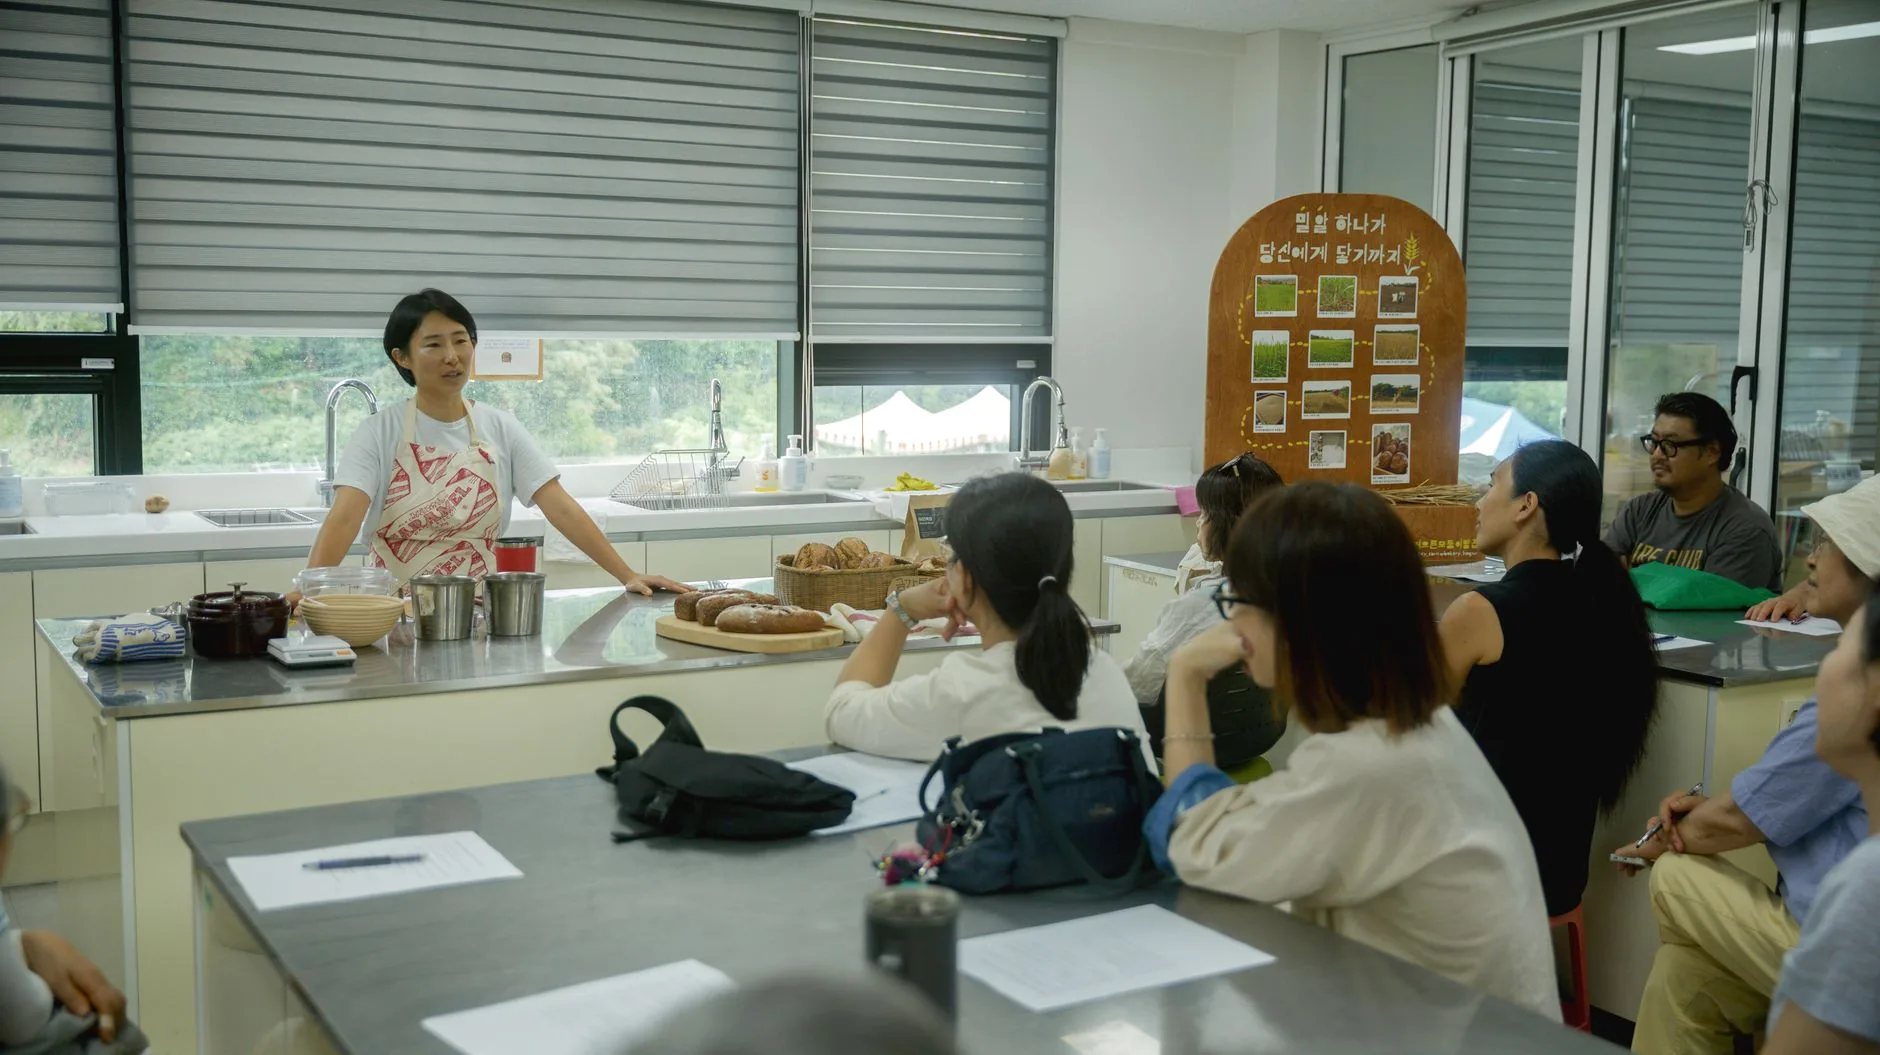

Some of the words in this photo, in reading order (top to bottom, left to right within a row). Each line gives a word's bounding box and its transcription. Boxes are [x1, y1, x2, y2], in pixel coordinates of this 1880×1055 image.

[1295, 211, 1329, 234] 밀알
[1334, 211, 1387, 235] 하나가
[1259, 240, 1328, 264] 당신에게
[1335, 242, 1401, 266] 닿기까지
